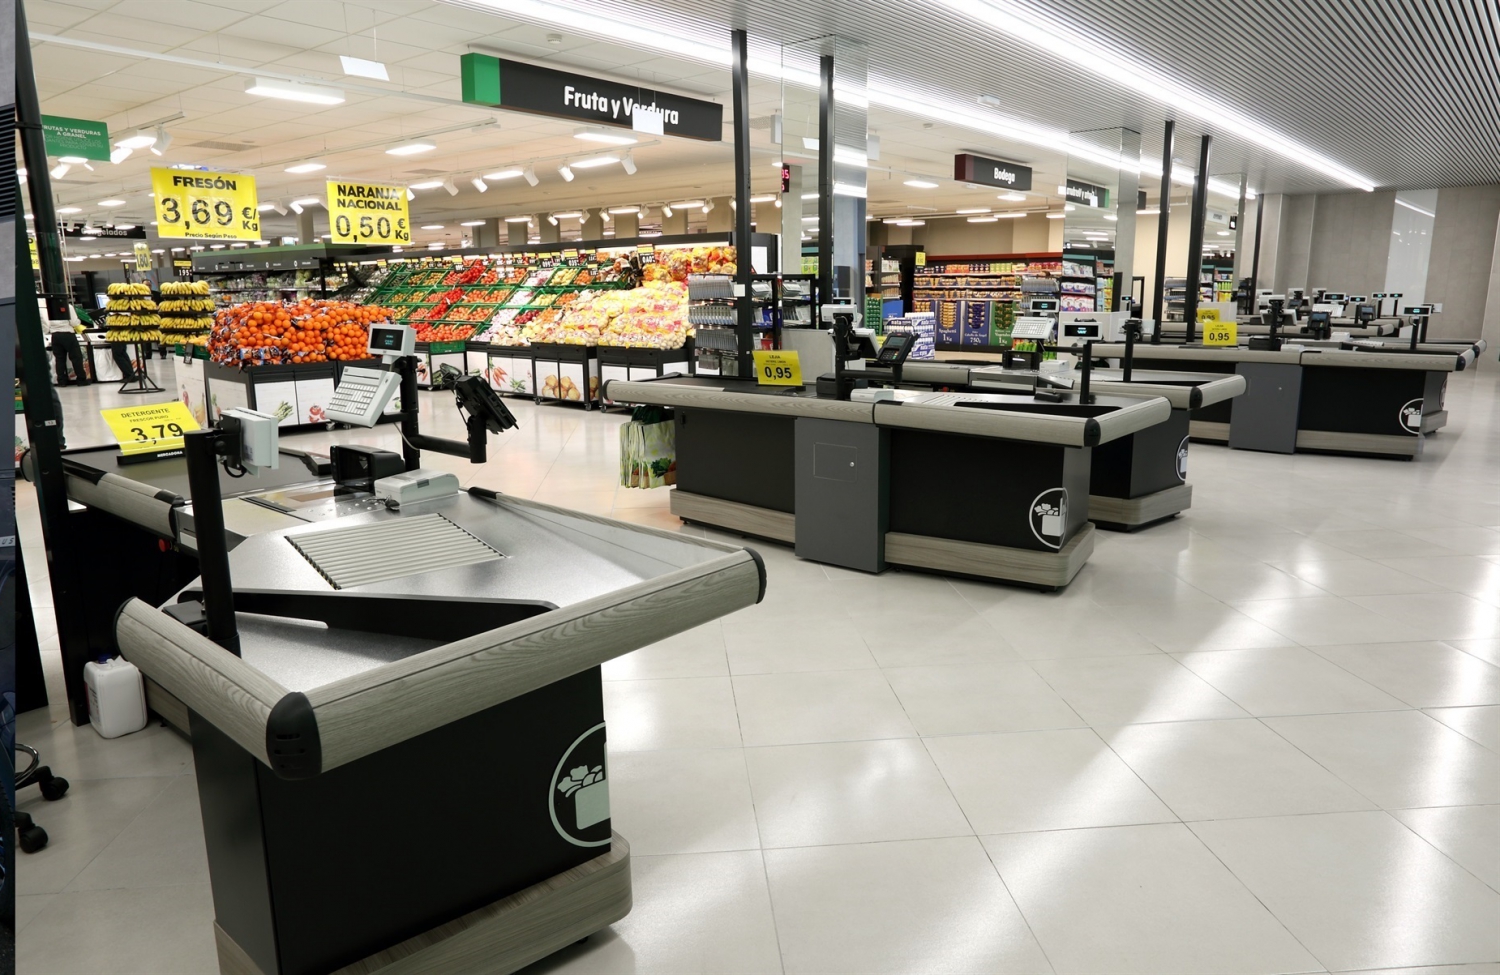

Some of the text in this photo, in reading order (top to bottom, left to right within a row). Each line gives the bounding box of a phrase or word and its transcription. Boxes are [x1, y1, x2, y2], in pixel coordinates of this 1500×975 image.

[564, 85, 608, 112] Fruta
[611, 99, 621, 119] y
[173, 175, 237, 191] FRESÓN
[993, 167, 1016, 185] Bodega
[337, 184, 400, 201] NARANJA
[337, 198, 402, 212] NACIONAL
[161, 197, 233, 229] 3,69
[80, 227, 128, 237] Cgelados
[242, 220, 258, 232] Kg
[335, 214, 391, 243] 0,50
[395, 229, 409, 242] Kg
[1209, 332, 1230, 342] 0,95
[764, 366, 792, 380] 0,95
[121, 408, 170, 418] DETERGENTE
[130, 422, 184, 445] 3,79
[156, 450, 183, 458] MERCADONA
